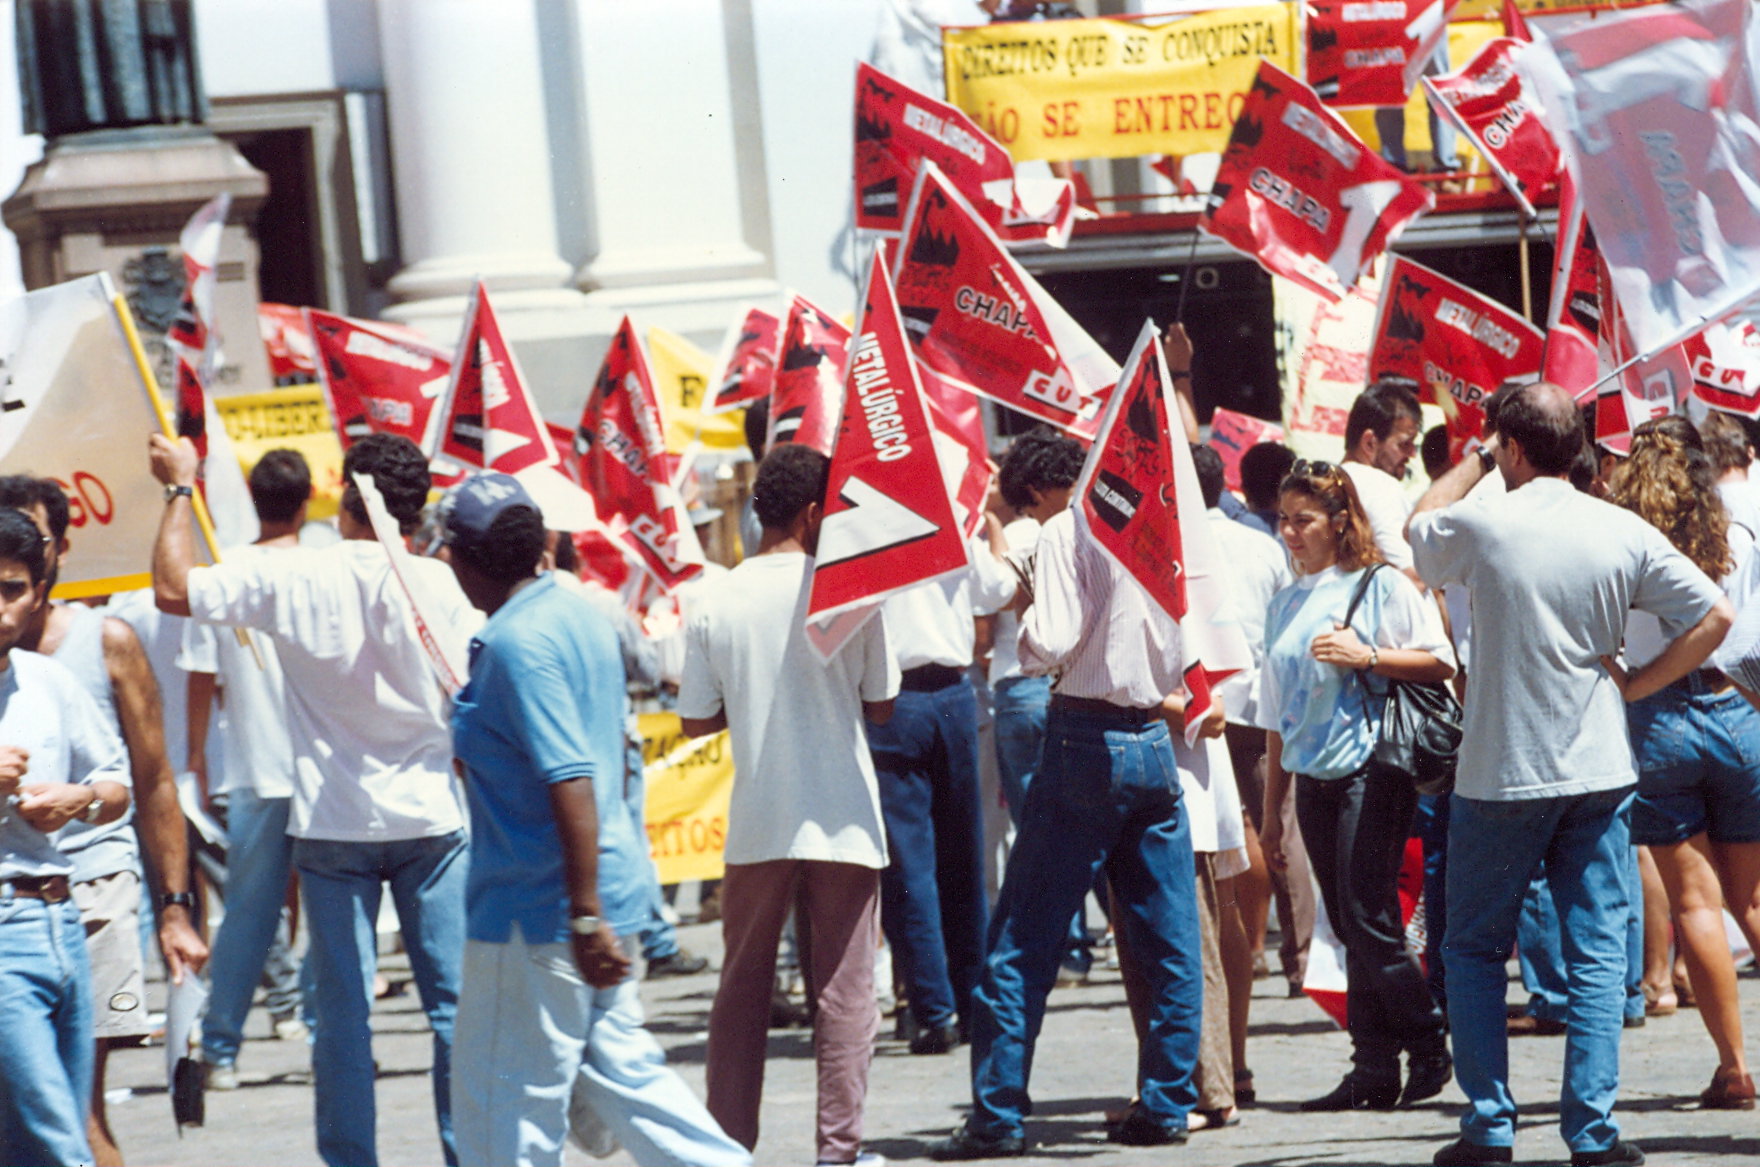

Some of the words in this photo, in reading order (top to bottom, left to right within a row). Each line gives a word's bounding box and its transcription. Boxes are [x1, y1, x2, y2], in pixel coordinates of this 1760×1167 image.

[963, 39, 1057, 80] DIREITOS
[1067, 35, 1108, 77] QUE
[1122, 35, 1148, 64] SE
[1163, 21, 1278, 67] CONQUISTA
[1042, 101, 1080, 138] SE
[1250, 166, 1331, 234] CHAPA
[1340, 180, 1402, 289] 1
[1032, 376, 1096, 412] CUT
[814, 475, 943, 572] 1
